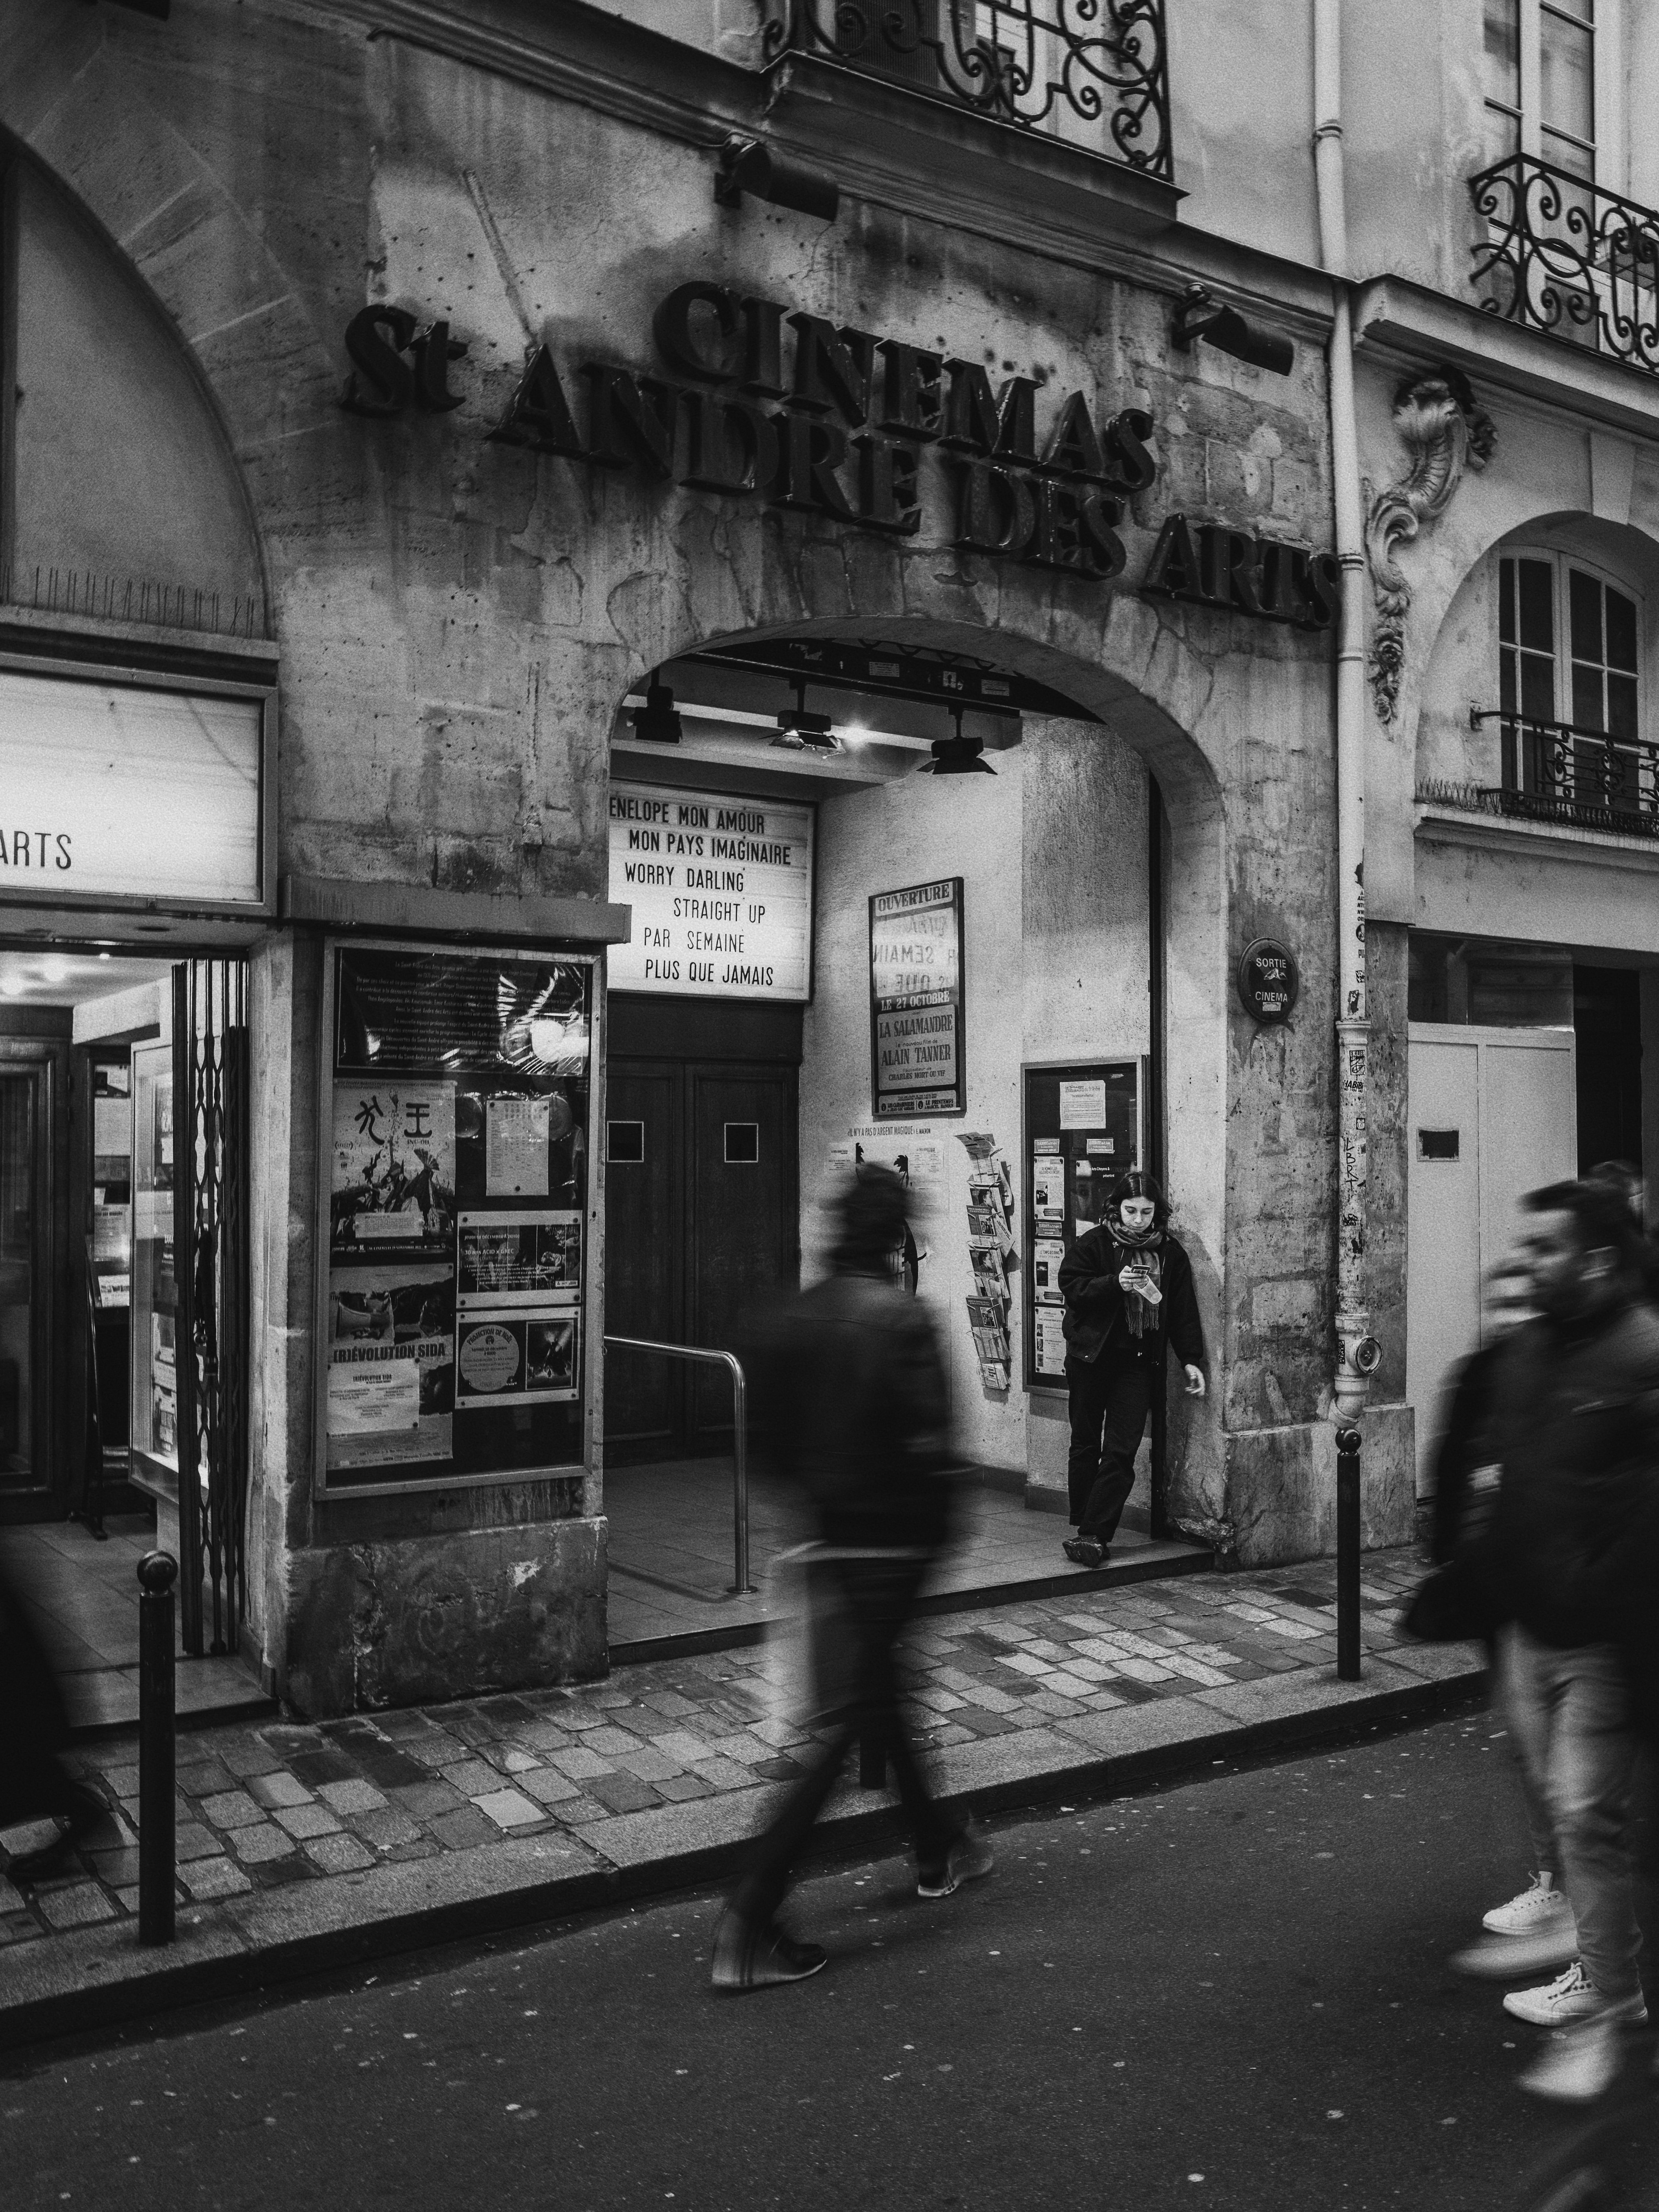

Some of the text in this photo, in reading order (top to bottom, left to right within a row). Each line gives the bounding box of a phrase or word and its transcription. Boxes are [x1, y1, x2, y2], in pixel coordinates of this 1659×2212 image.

[652, 280, 1156, 493] CINEMAS
[340, 303, 1340, 631] St ANDRE DES ARTS
[609, 796, 765, 834] ENELOPE MON AMOUR
[0, 829, 72, 869] ARTS
[629, 829, 791, 865] MON PAYS IMAGINAIRE
[625, 862, 744, 892] WORRY DARLING
[674, 898, 766, 924] STRAIGHT UP
[878, 884, 950, 912] OUVERTURE
[644, 927, 744, 953] PAR SEMAINE
[645, 959, 774, 986] PLUS QUE JAMAIS
[1255, 957, 1287, 969] SORTIE
[881, 990, 950, 1011] LE 27 OCTOBRE
[1255, 991, 1288, 1003] CINEMA
[879, 1014, 953, 1039] LA SALAMANDRE
[881, 1044, 951, 1066] ALAIN TANNER
[888, 1073, 912, 1081] CHARLES
[861, 1128, 864, 1136] A
[873, 1126, 893, 1136] D'ARGENT
[466, 1328, 495, 1346] PROJECTION
[417, 1343, 446, 1358] SIDA
